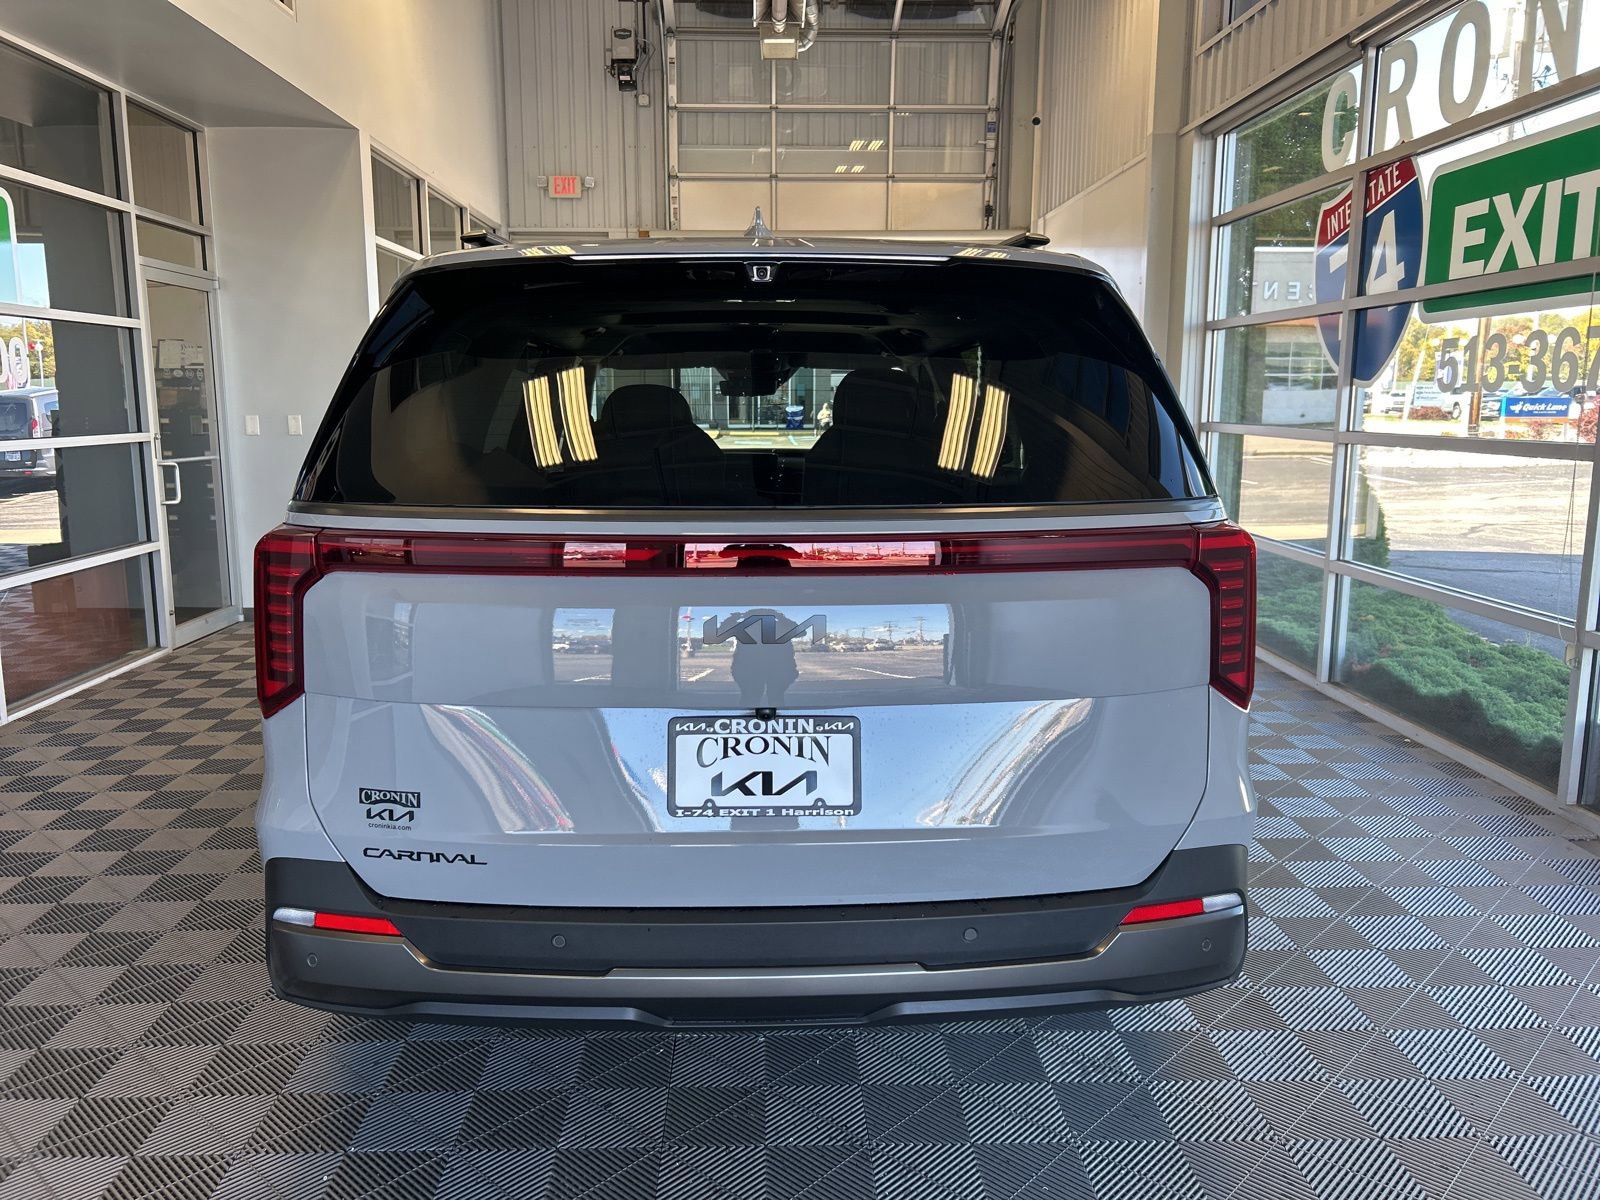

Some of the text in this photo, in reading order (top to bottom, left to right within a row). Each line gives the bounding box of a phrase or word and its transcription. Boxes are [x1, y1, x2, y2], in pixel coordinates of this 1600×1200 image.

[553, 176, 577, 195] EXIT
[1327, 162, 1402, 240] INTETATE
[1449, 169, 1600, 281] EXIT
[1522, 402, 1568, 411] Quick Lane
[703, 614, 827, 645] KIA
[675, 718, 855, 734] KIA CRONIN KIA
[696, 735, 832, 768] CRONIN
[711, 770, 818, 797] KIA
[360, 789, 419, 808] CRONIN
[366, 807, 415, 823] KIA
[675, 807, 854, 817] I-74 EXIT 1 Harrison
[368, 821, 412, 831] croninkia.com
[362, 847, 488, 865] CARNIVAL
